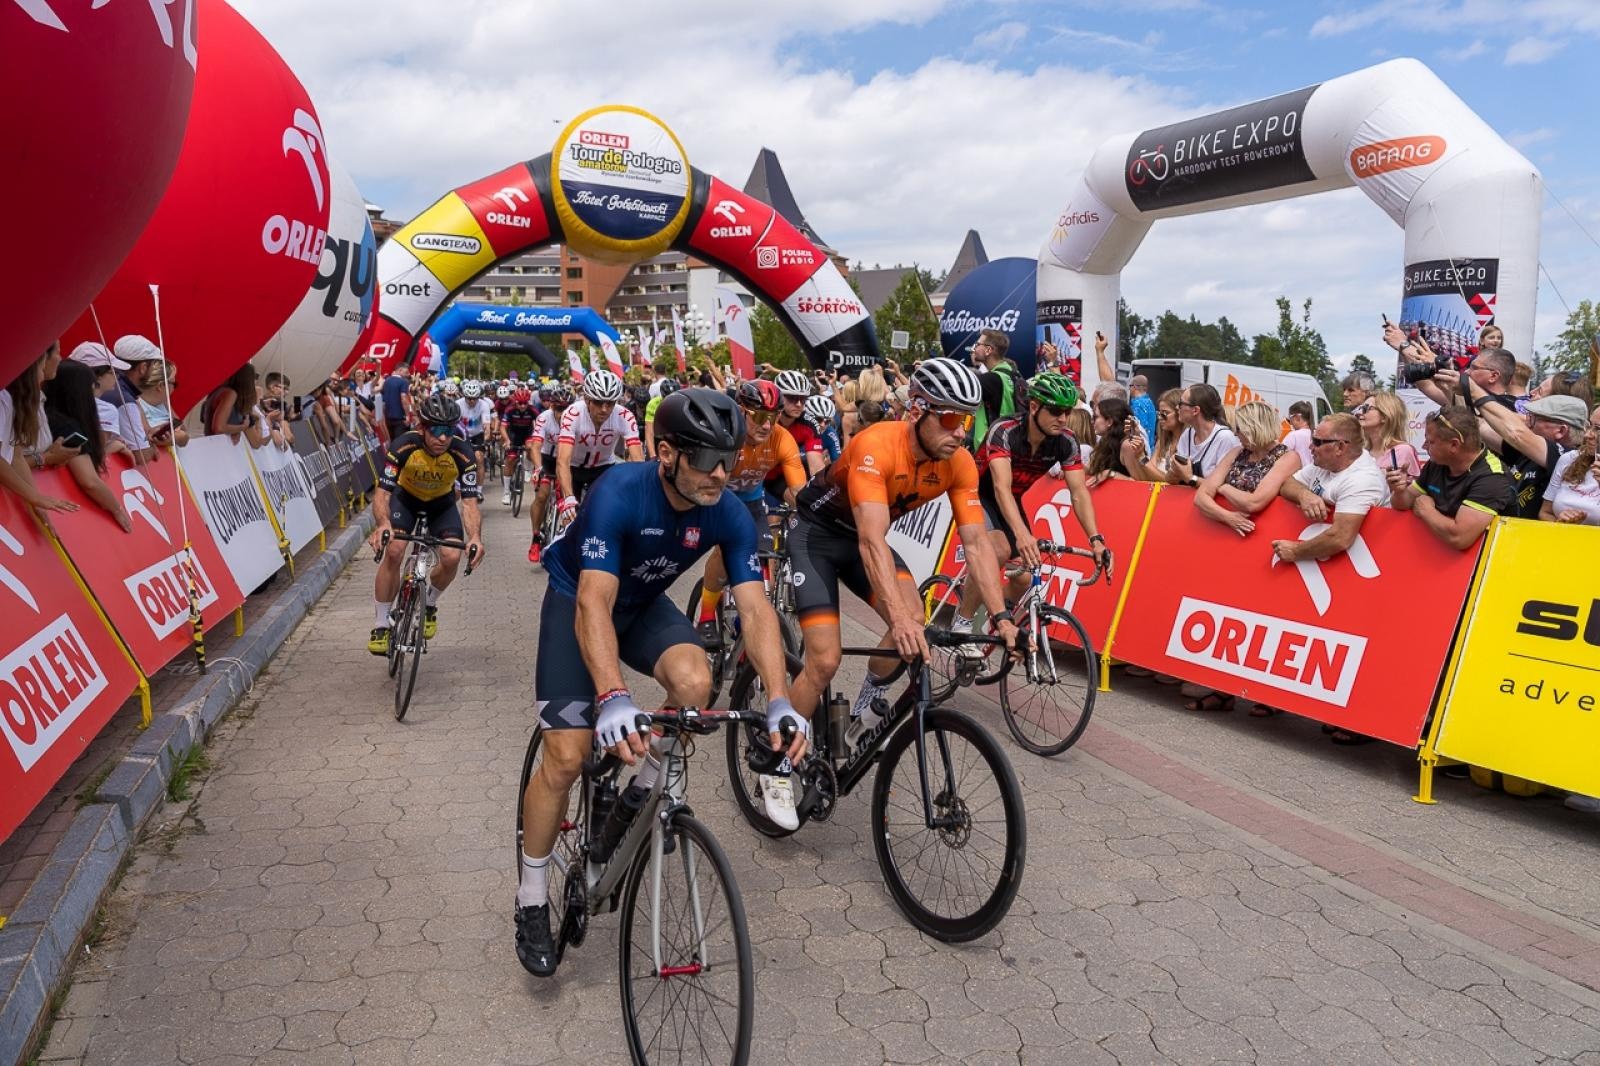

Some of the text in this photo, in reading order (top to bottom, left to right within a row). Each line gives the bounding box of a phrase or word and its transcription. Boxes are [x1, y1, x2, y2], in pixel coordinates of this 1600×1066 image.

[582, 132, 627, 148] ORLEN
[1174, 111, 1297, 164] BIKE EXPO
[1174, 142, 1295, 177] NARODOWY TEST ROWEROWY
[1356, 142, 1432, 171] BAFANG
[572, 191, 608, 207] Hotel
[486, 212, 531, 228] ORLEN
[1058, 211, 1100, 227] Cofidis
[710, 225, 752, 238] ORLEN
[262, 214, 327, 266] ORLE
[416, 237, 477, 250] LANGTEAM
[782, 250, 813, 258] POLSKIE
[782, 257, 815, 265] RADIO
[1413, 267, 1486, 283] BIKE EXPO
[385, 282, 431, 296] onet
[798, 303, 861, 316] SPORTOWY
[1051, 305, 1075, 315] EXPO
[561, 406, 580, 431] XTC
[618, 409, 638, 432] XTC
[578, 433, 614, 447] XTC
[137, 557, 210, 626] ORLEN
[1181, 609, 1350, 692] ORLEN
[0, 629, 97, 745] ORLEN
